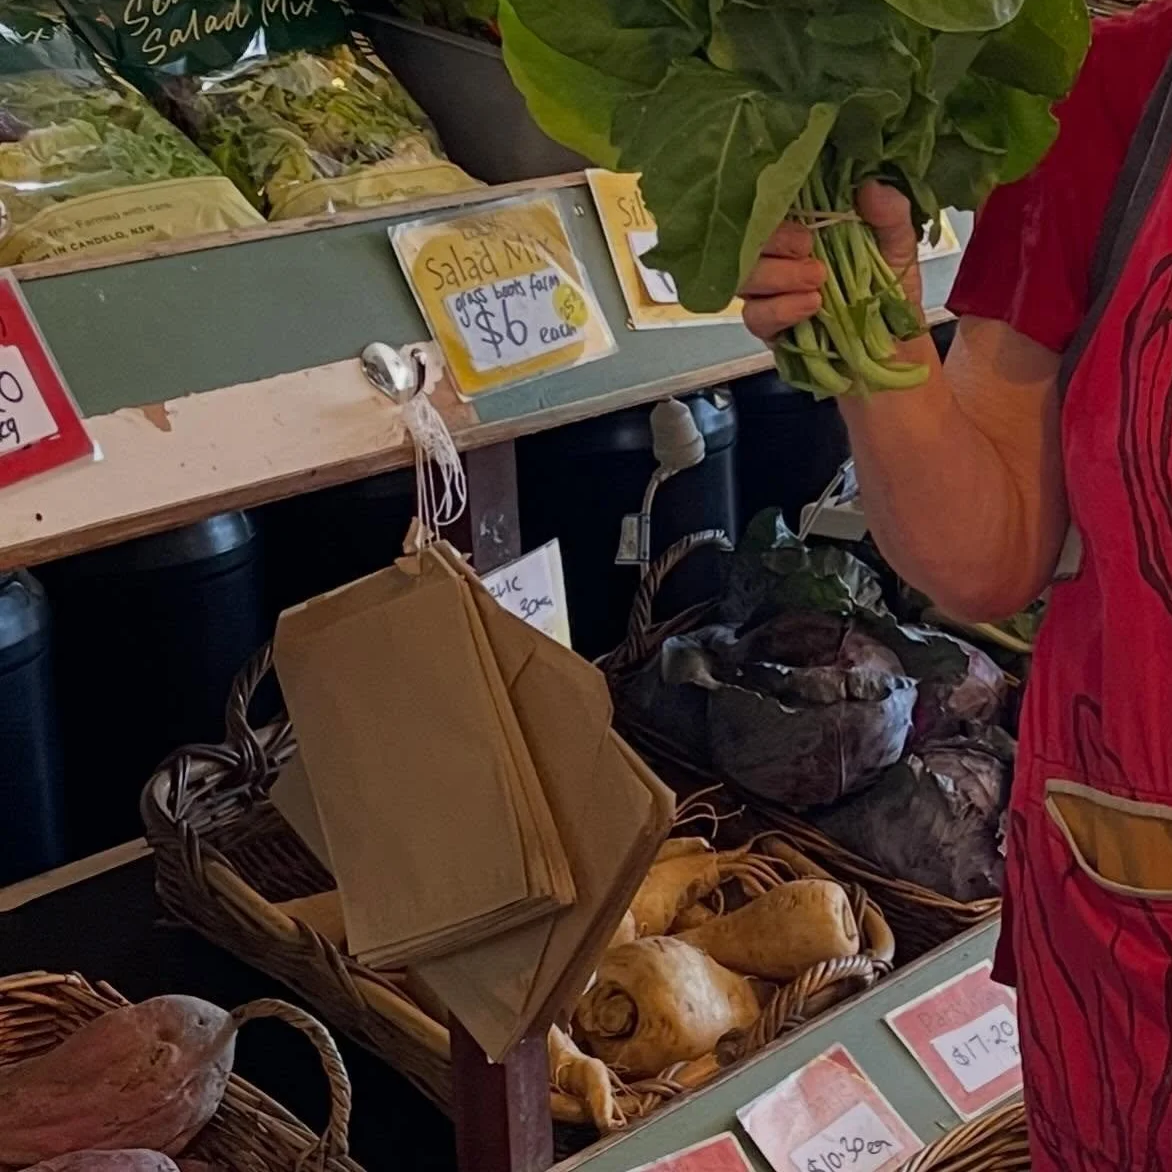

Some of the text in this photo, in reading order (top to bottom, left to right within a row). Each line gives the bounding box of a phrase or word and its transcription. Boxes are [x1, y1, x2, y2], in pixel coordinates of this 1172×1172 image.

[52, 223, 156, 256] IN CANDELO, NSW
[425, 231, 554, 291] Salad Mix
[529, 273, 561, 301] farm
[475, 299, 528, 358] $6
[539, 324, 577, 344] each
[951, 1019, 1014, 1067] $17.20
